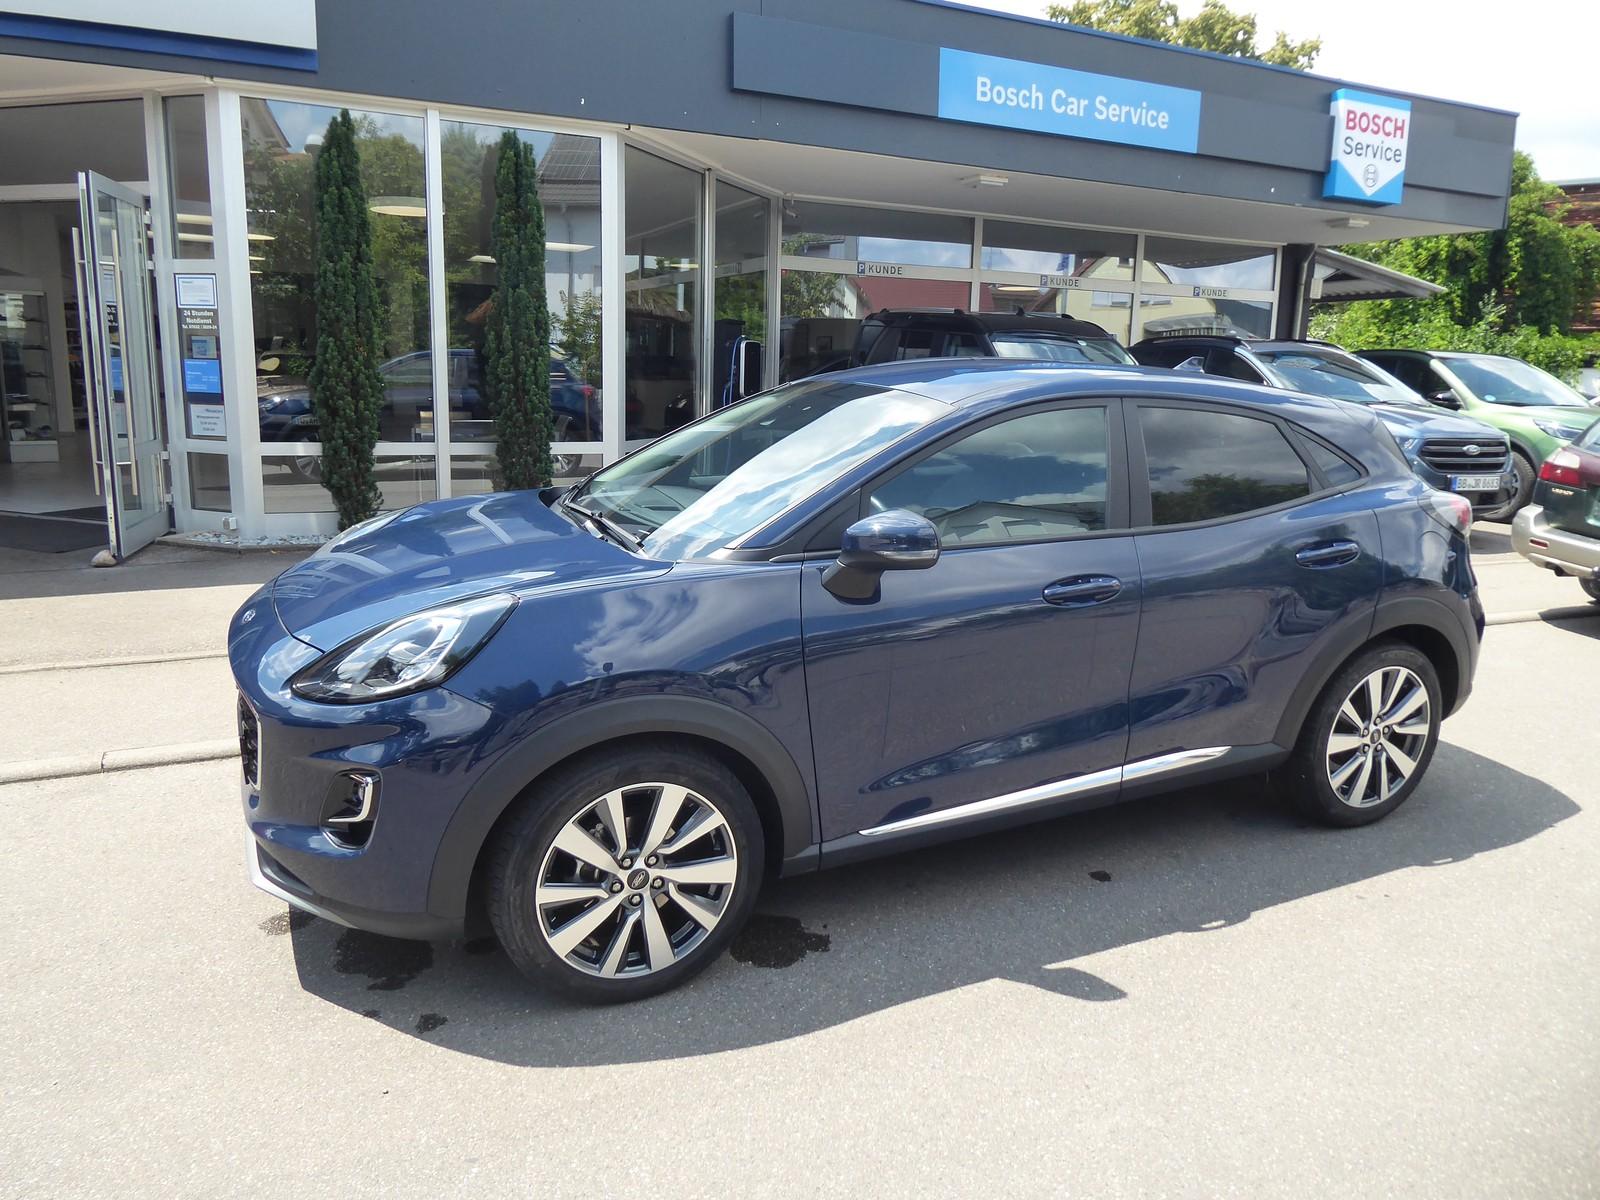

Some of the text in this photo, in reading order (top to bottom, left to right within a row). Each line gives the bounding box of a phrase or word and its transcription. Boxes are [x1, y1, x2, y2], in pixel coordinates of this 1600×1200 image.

[976, 76, 1169, 130] Bosch Car Service
[1345, 109, 1406, 140] BOSCH
[1343, 136, 1402, 163] Service
[868, 264, 903, 275] KUNDE
[1050, 277, 1079, 287] KUNDE
[1201, 288, 1228, 298] KUNDE
